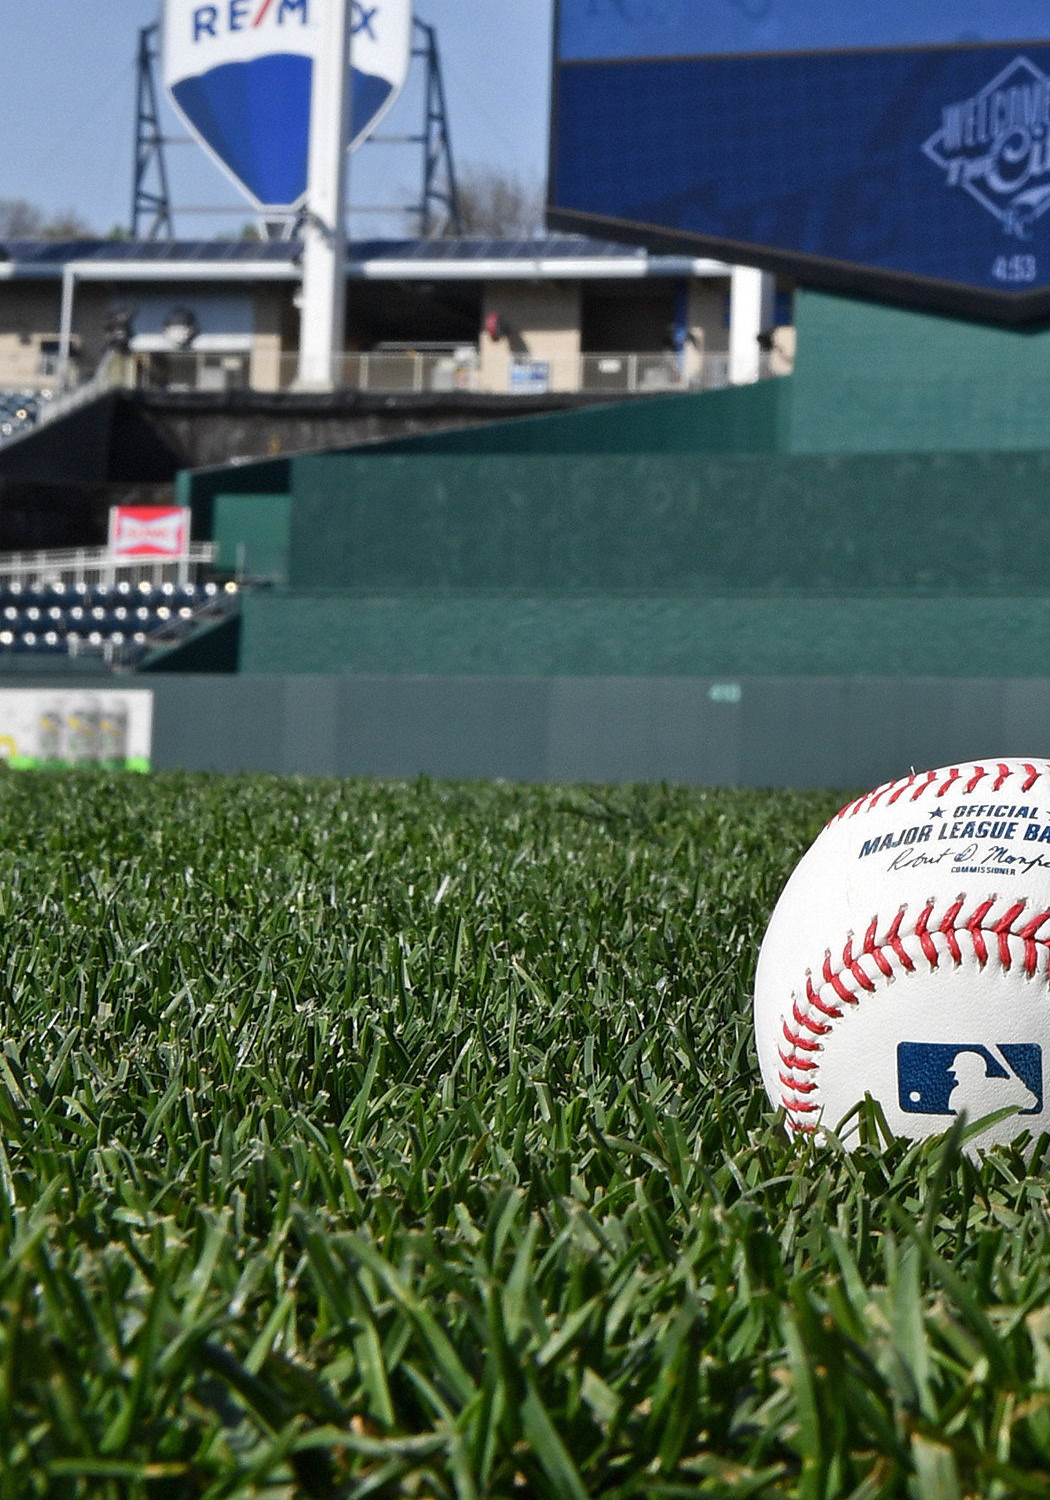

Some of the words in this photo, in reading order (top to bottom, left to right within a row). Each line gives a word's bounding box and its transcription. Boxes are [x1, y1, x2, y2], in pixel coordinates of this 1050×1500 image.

[953, 805, 1039, 820] OFFICIAL
[858, 824, 933, 860] MAJOR
[937, 820, 1020, 841] LEAGUE
[950, 866, 1016, 877] COMMISSIONER
